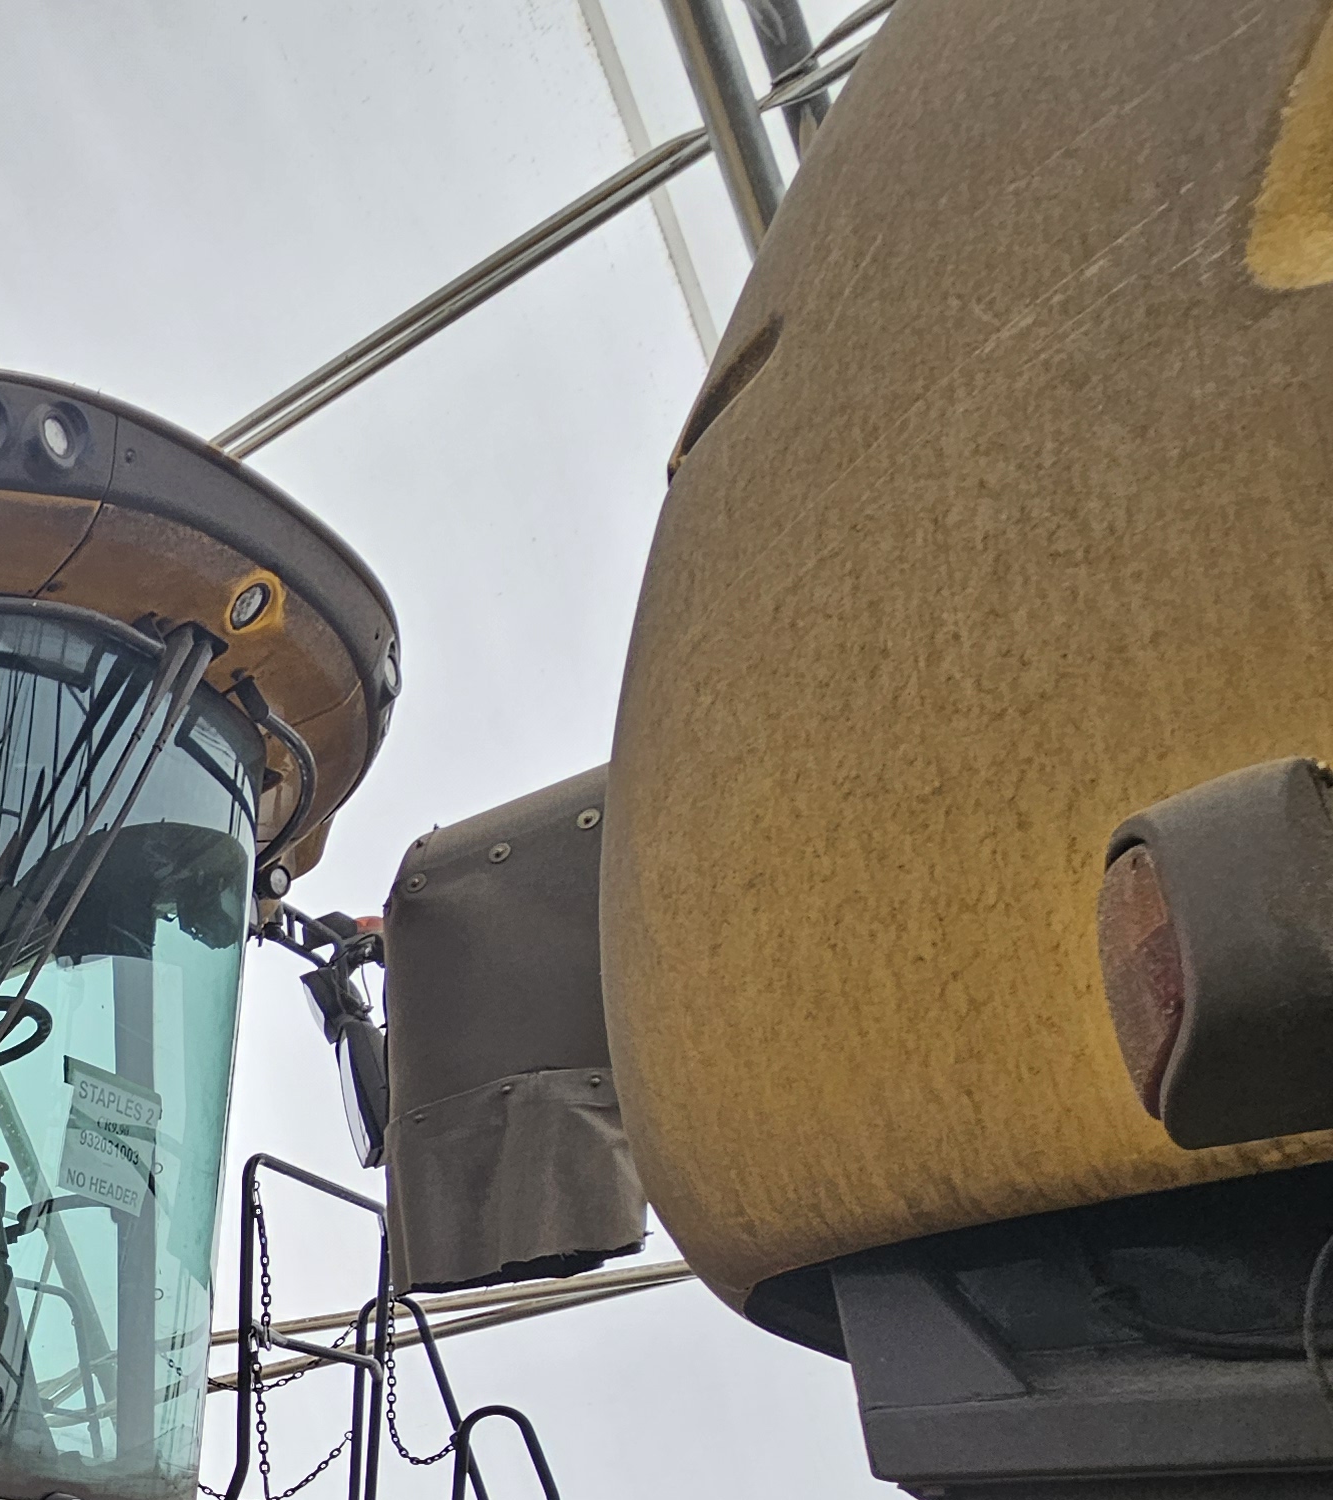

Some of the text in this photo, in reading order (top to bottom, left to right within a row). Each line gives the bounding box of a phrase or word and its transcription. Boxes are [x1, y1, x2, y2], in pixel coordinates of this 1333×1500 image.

[78, 1080, 155, 1126] STAPLES 2
[79, 1130, 139, 1166] 932031003
[66, 1167, 139, 1209] NO HEADER
